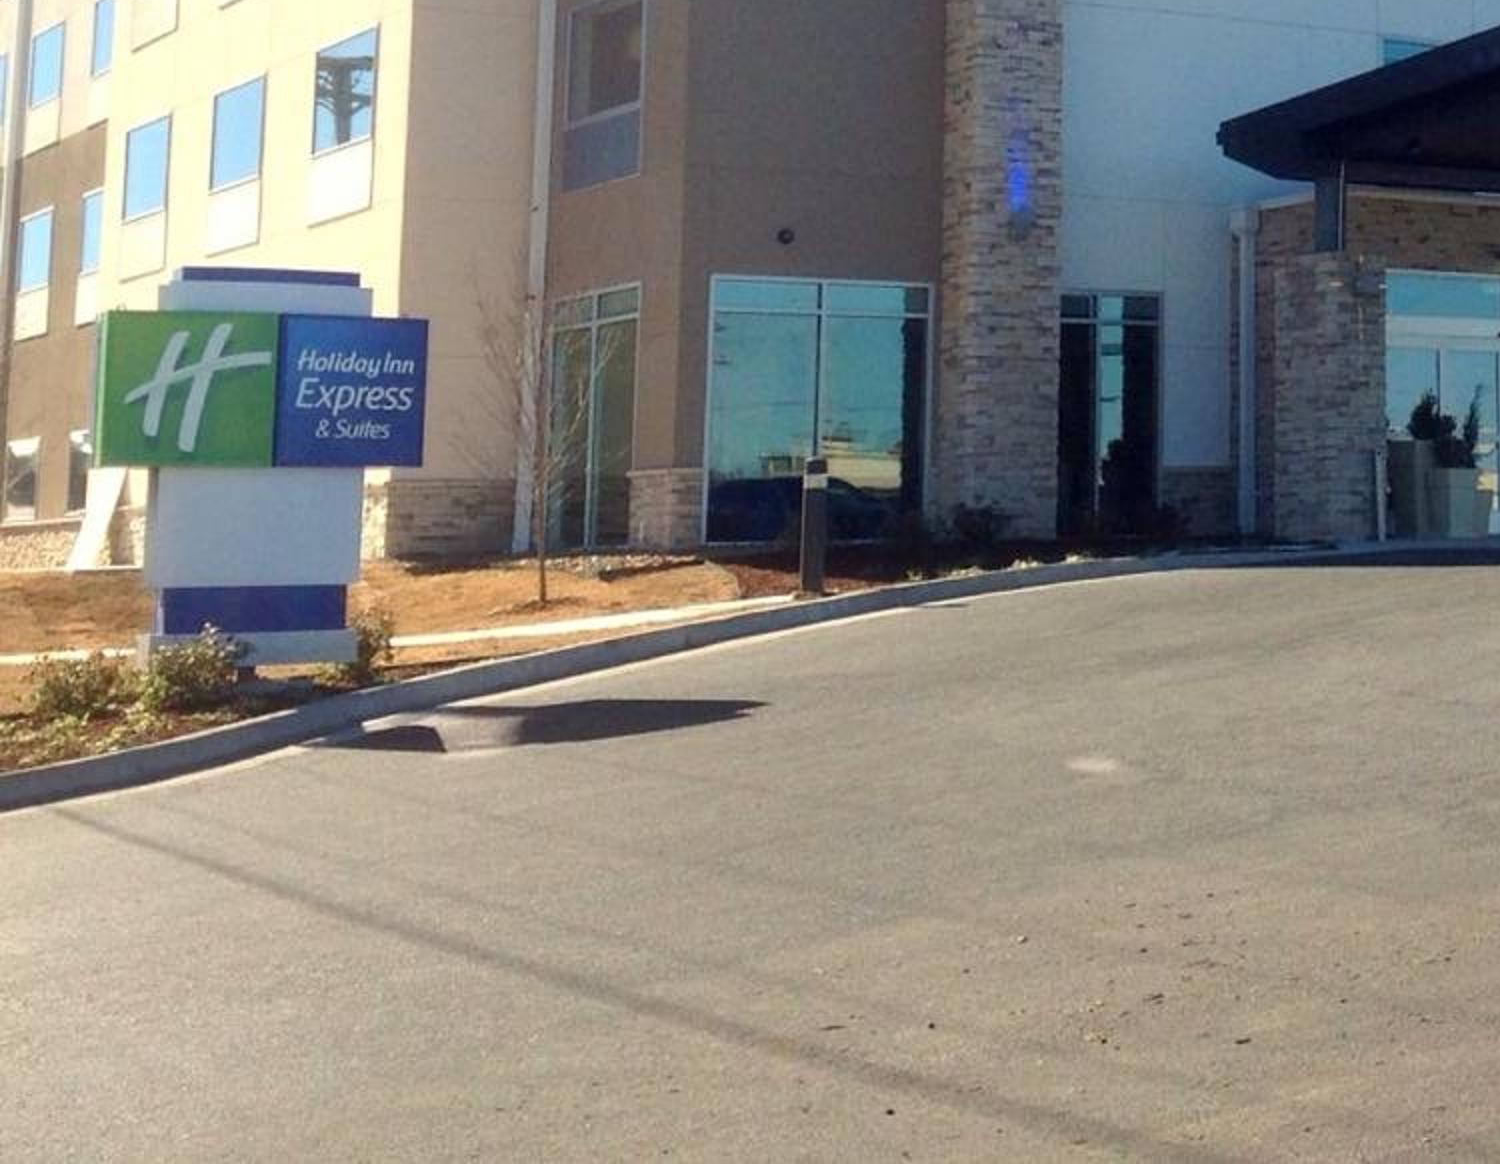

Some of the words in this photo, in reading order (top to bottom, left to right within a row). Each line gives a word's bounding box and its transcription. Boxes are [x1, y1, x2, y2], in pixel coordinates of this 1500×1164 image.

[297, 349, 381, 378] Holiday
[383, 350, 415, 375] Inn
[295, 377, 415, 417] Express
[315, 418, 330, 439] &
[335, 418, 393, 439] Suites
